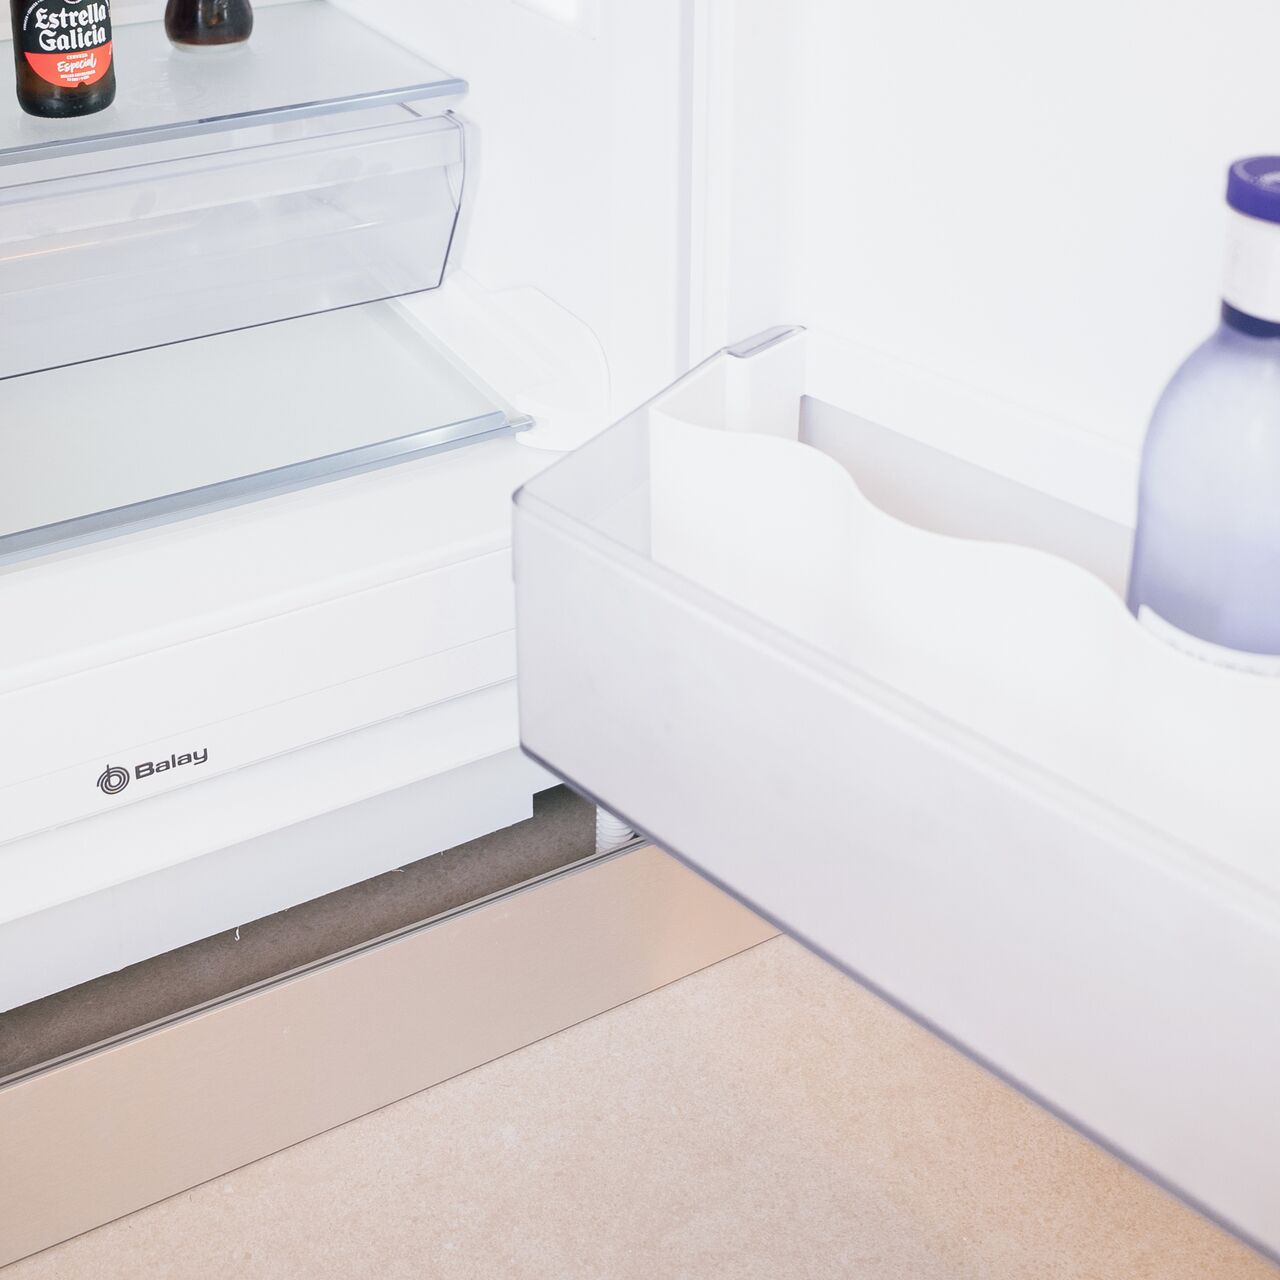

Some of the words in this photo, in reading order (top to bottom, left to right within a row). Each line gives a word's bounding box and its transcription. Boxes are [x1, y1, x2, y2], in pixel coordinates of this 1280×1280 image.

[34, 2, 107, 30] Estrella
[39, 24, 107, 52] Galicia
[56, 53, 97, 73] Especial
[134, 748, 209, 780] Balay
